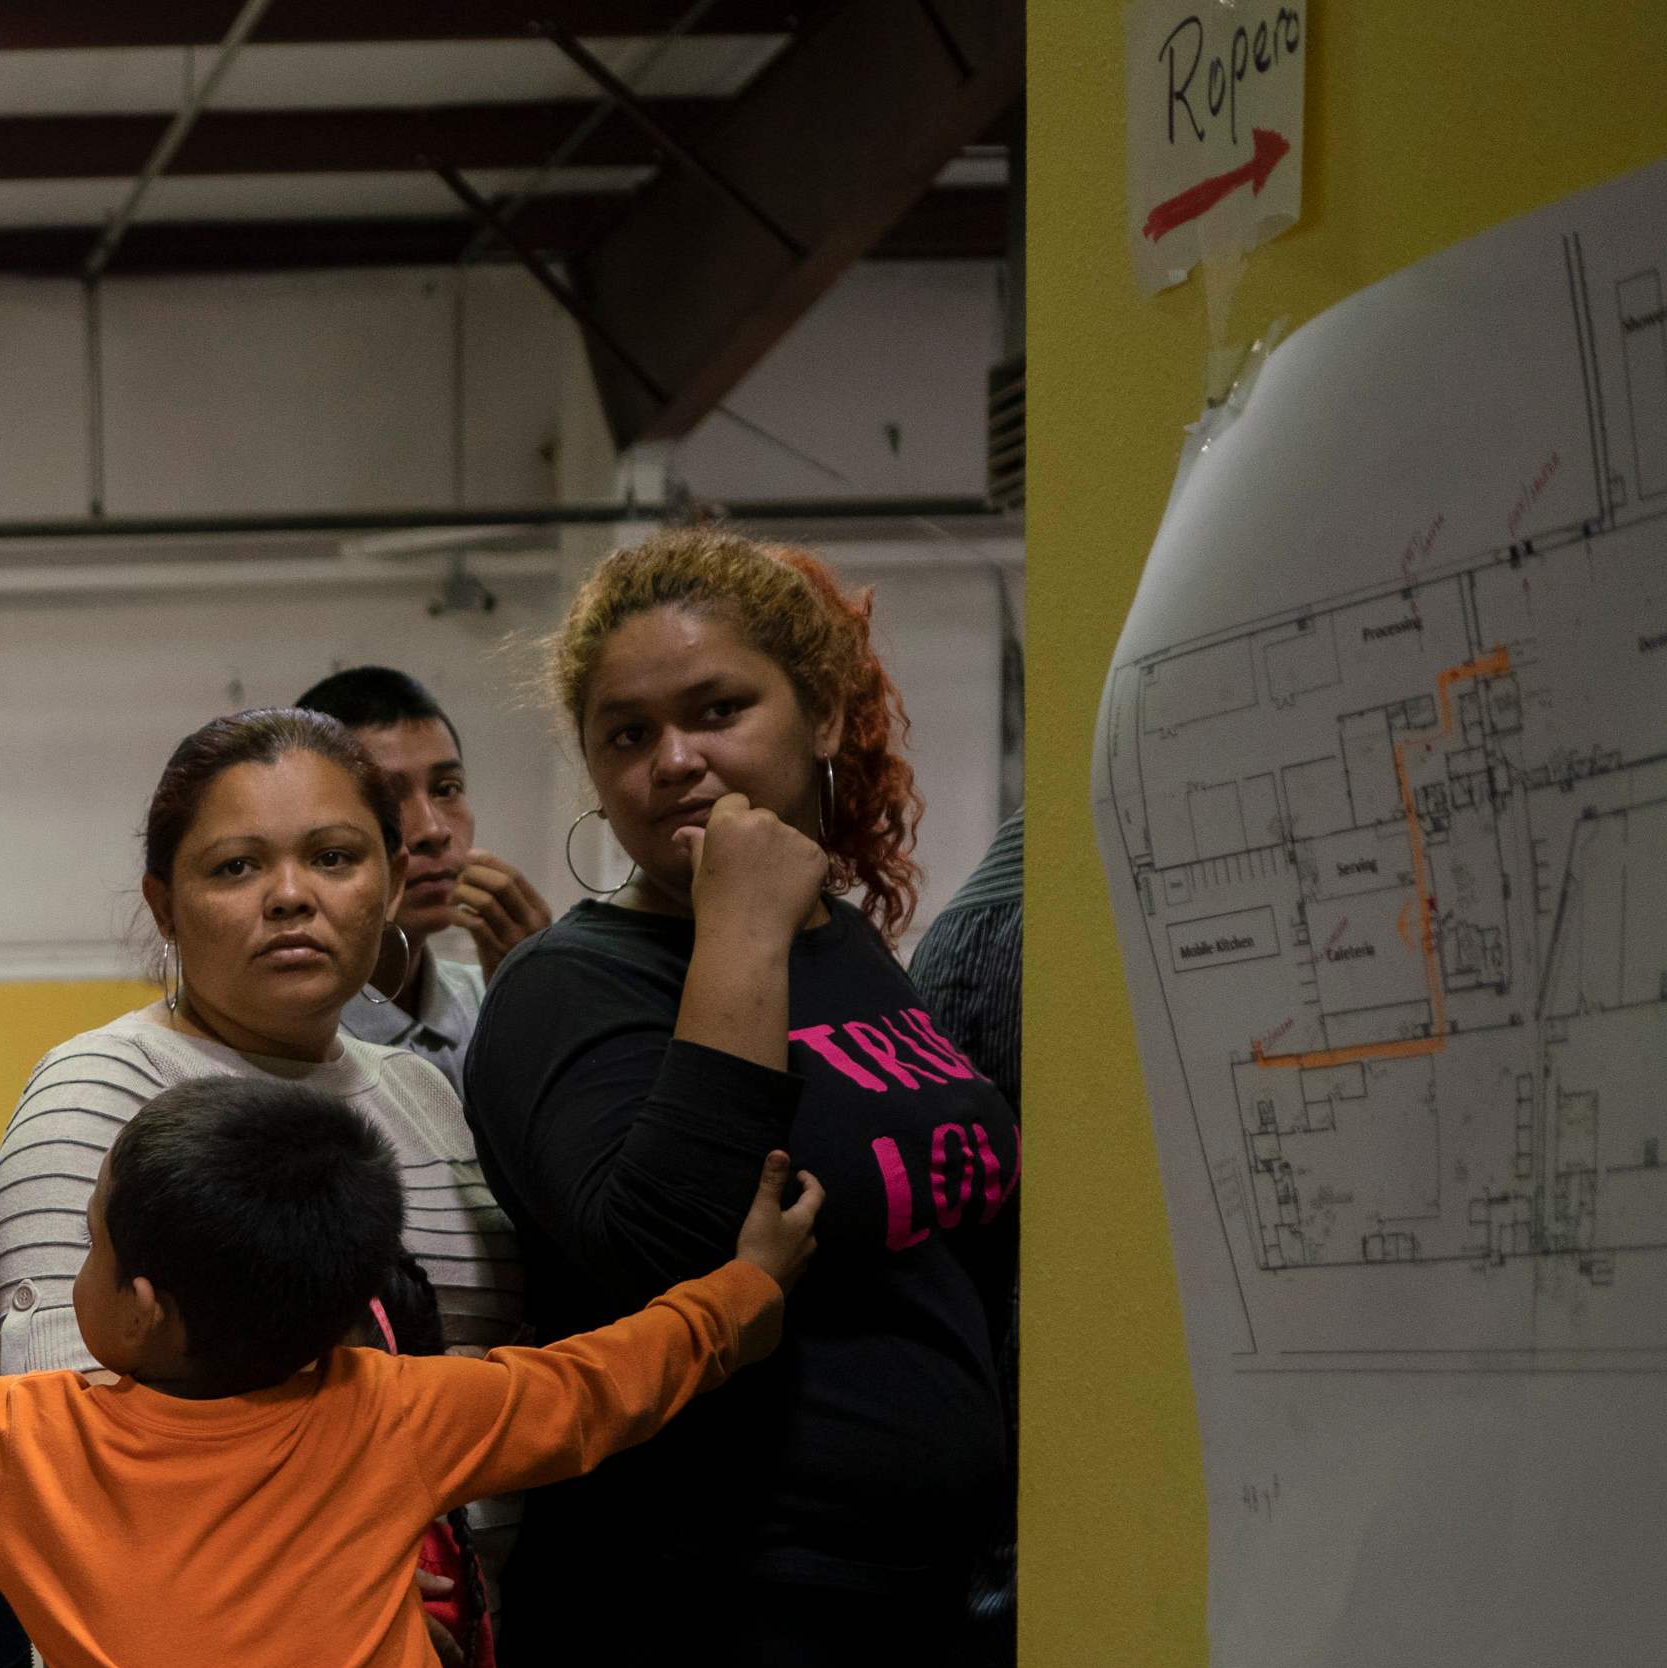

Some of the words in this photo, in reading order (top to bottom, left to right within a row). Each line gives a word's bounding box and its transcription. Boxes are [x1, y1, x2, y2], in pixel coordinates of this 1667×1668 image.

[1158, 5, 1300, 145] Ropero
[1361, 617, 1423, 642] Processing
[1336, 858, 1378, 877] Serving
[1179, 941, 1214, 959] Mobile
[1216, 935, 1256, 952] Kitchen
[1326, 941, 1375, 963] Cafeteria
[870, 1121, 1021, 1255] LOV
